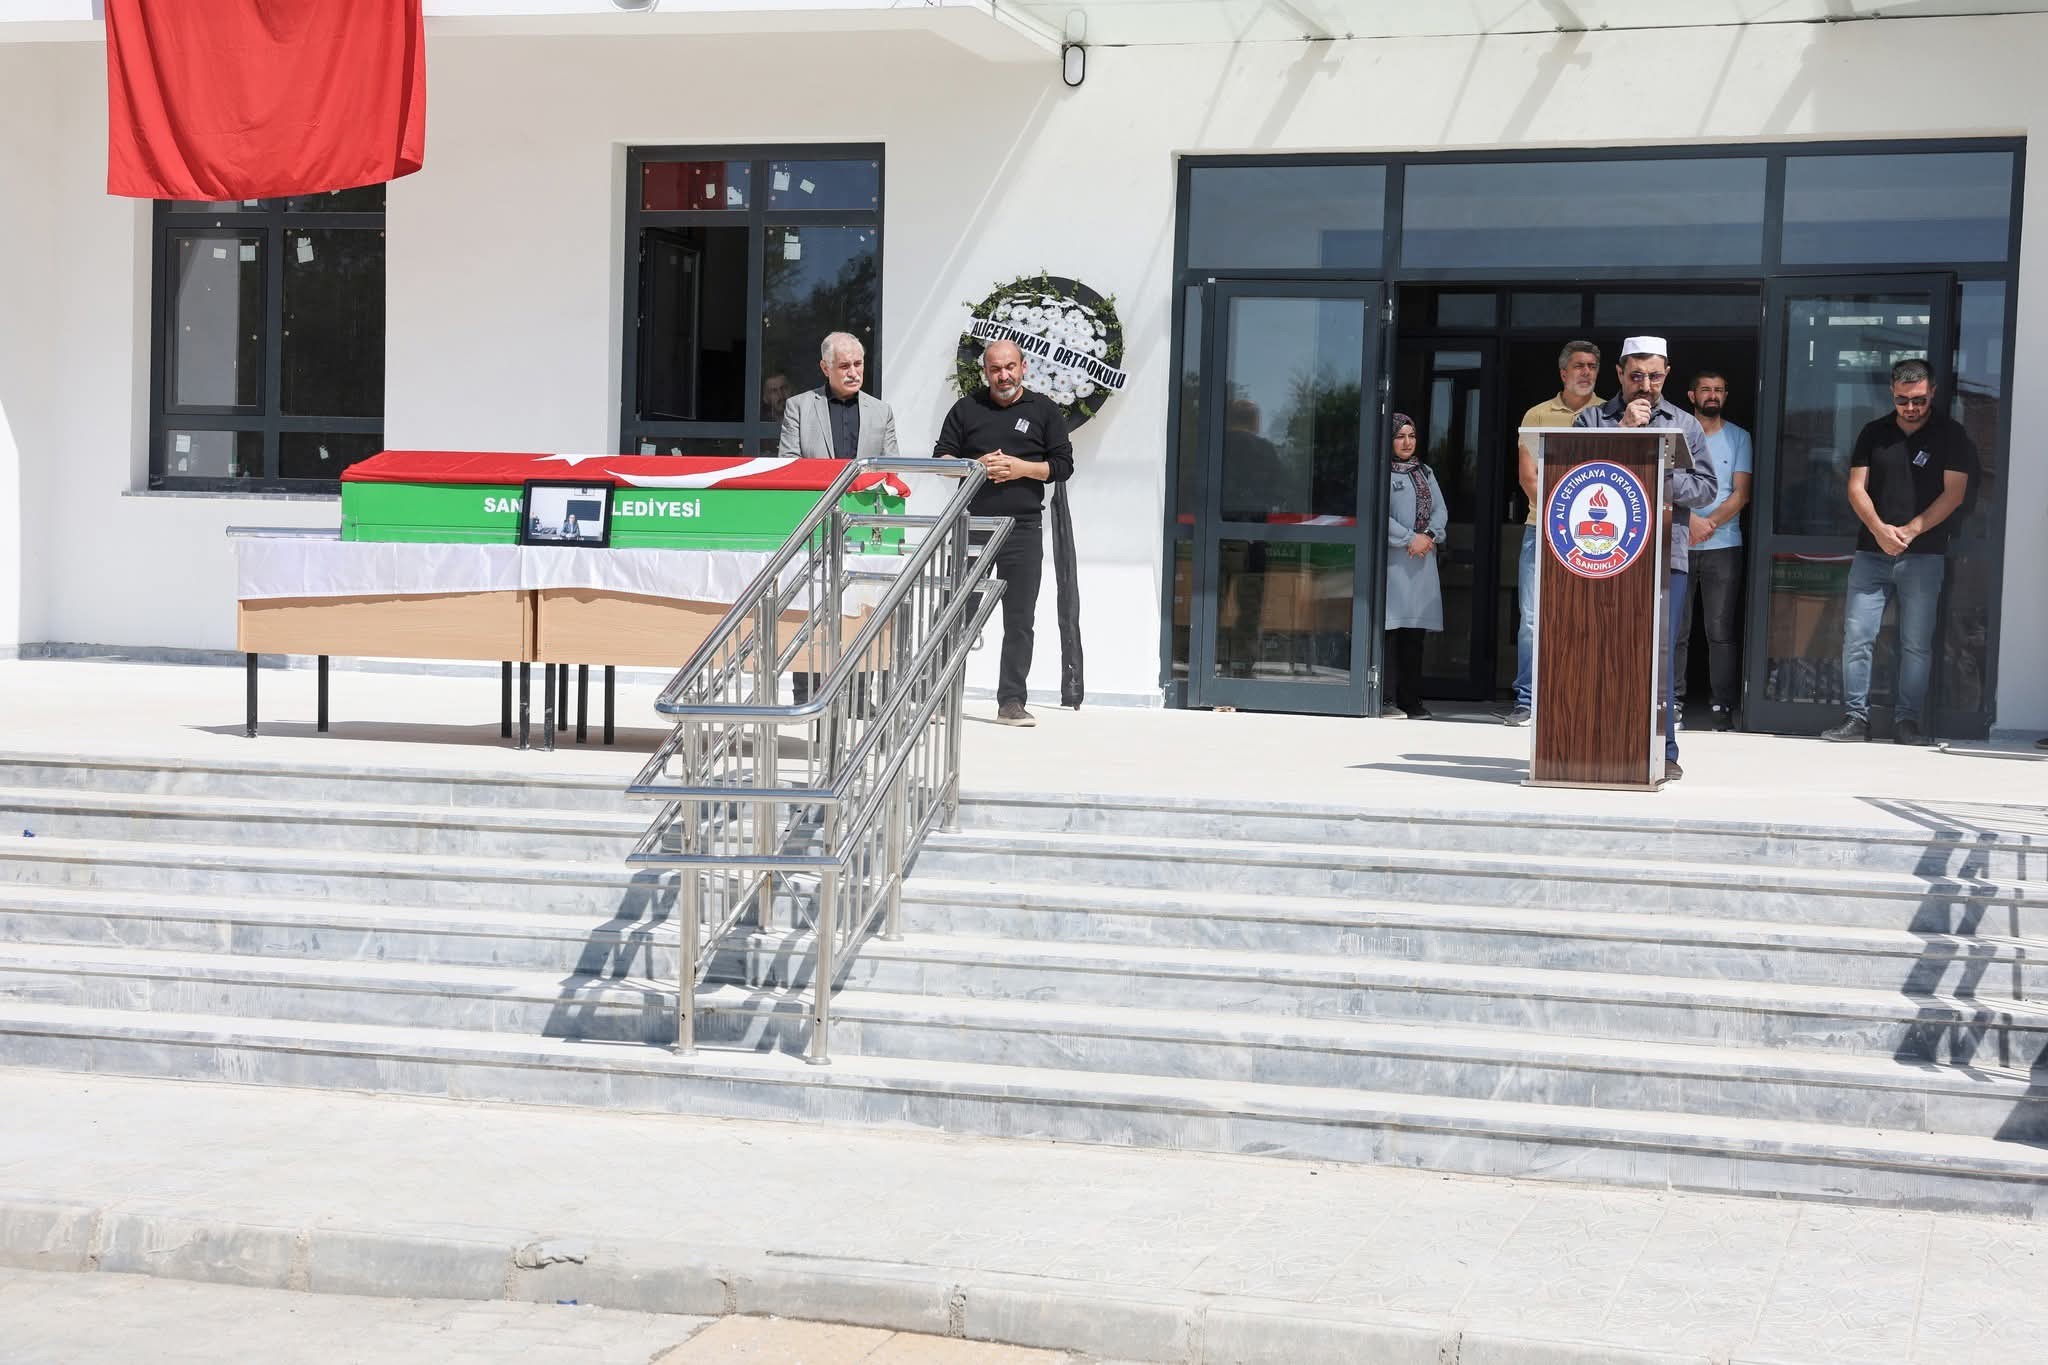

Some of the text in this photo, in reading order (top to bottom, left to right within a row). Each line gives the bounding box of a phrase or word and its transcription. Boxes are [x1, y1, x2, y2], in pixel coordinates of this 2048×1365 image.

[1053, 346, 1126, 389] ORTAOKULU
[612, 498, 701, 517] LEDİYESİ
[1561, 469, 1606, 500] ÇETİNKAYA
[1610, 472, 1641, 522] ORTAOKULU
[1575, 557, 1617, 570] SANDIKLI
